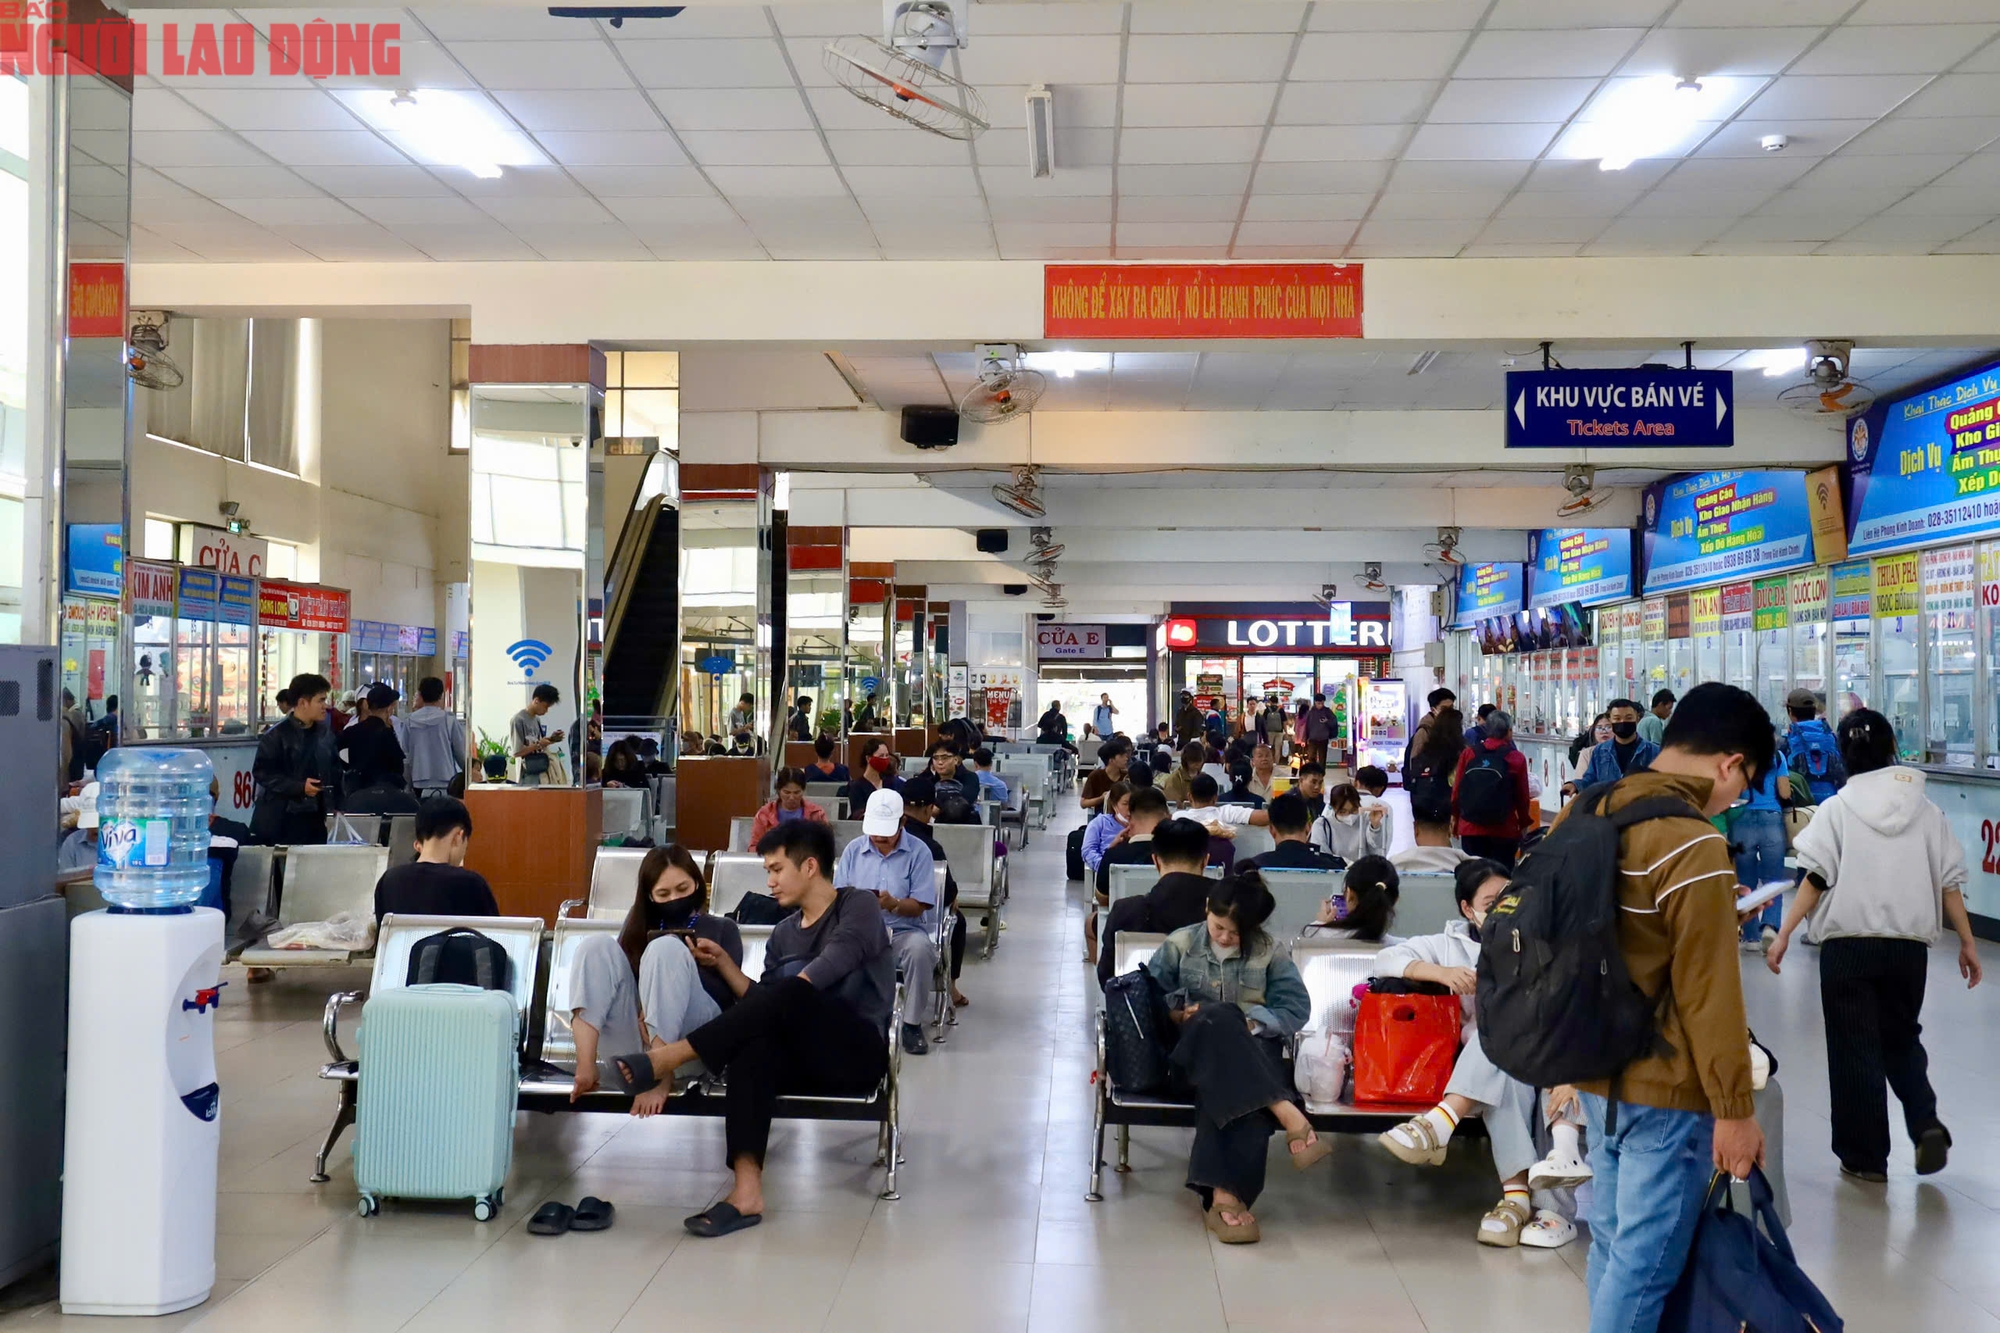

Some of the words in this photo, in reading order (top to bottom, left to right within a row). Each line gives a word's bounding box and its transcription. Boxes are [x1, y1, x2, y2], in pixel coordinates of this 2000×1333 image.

[1052, 279, 1088, 319] KHÔNG
[1091, 272, 1107, 319] ĐỂ
[1109, 274, 1130, 319] XẢY
[1134, 286, 1148, 319] RA
[1185, 270, 1201, 319] NỔ
[1203, 278, 1216, 319] LÀ
[1220, 286, 1249, 325] HẠNH
[1254, 278, 1282, 319] PHÚC
[1286, 274, 1307, 319] CỦA
[1310, 286, 1330, 325] MỌI
[1334, 278, 1355, 319] NHÀ
[1537, 386, 1579, 408] KHU
[1584, 384, 1626, 413] VỰC
[1632, 382, 1674, 408] BÁN
[1679, 382, 1704, 408] VÉ
[1903, 401, 1925, 418] Khai
[1928, 393, 1952, 411] Thác
[1956, 383, 1979, 404] Dịch
[1567, 419, 1629, 436] Tickets
[1633, 420, 1675, 436] Area
[1950, 409, 1994, 431] Quảng
[1955, 430, 1982, 449] Kho
[1900, 446, 1925, 481] Dịch
[1927, 442, 1942, 474] Vụ
[1952, 450, 1974, 473] Ẩm
[1958, 472, 1985, 494] Xếp
[1696, 494, 1718, 509] Quảng
[1719, 487, 1734, 501] Cáo
[1699, 510, 1713, 522] Kho
[1714, 506, 1730, 518] Giao
[1731, 498, 1751, 513] Nhận
[1752, 490, 1774, 506] Hàng
[1710, 521, 1727, 537] Thực
[1896, 521, 1907, 534] Kinh
[1927, 503, 1981, 528] 028-35112410
[1700, 537, 1714, 555] Xếp
[1726, 534, 1745, 550] Hàng
[199, 538, 240, 575] CỬA
[248, 554, 261, 577] C
[1723, 553, 1737, 569] 0938
[1737, 551, 1744, 565] 69
[1745, 549, 1752, 564] 69
[1752, 547, 1760, 562] 38
[152, 574, 173, 602] ANH
[1757, 581, 1773, 609] ĐỨC
[1982, 583, 2000, 606] KO
[274, 600, 288, 616] LONG
[1694, 591, 1707, 617] TÂN
[1896, 616, 1902, 633] 20
[1038, 627, 1079, 645] CỬA
[1086, 632, 1099, 645] E
[987, 690, 1010, 699] MENU
[233, 770, 252, 809] 86
[100, 828, 136, 850] Viva
